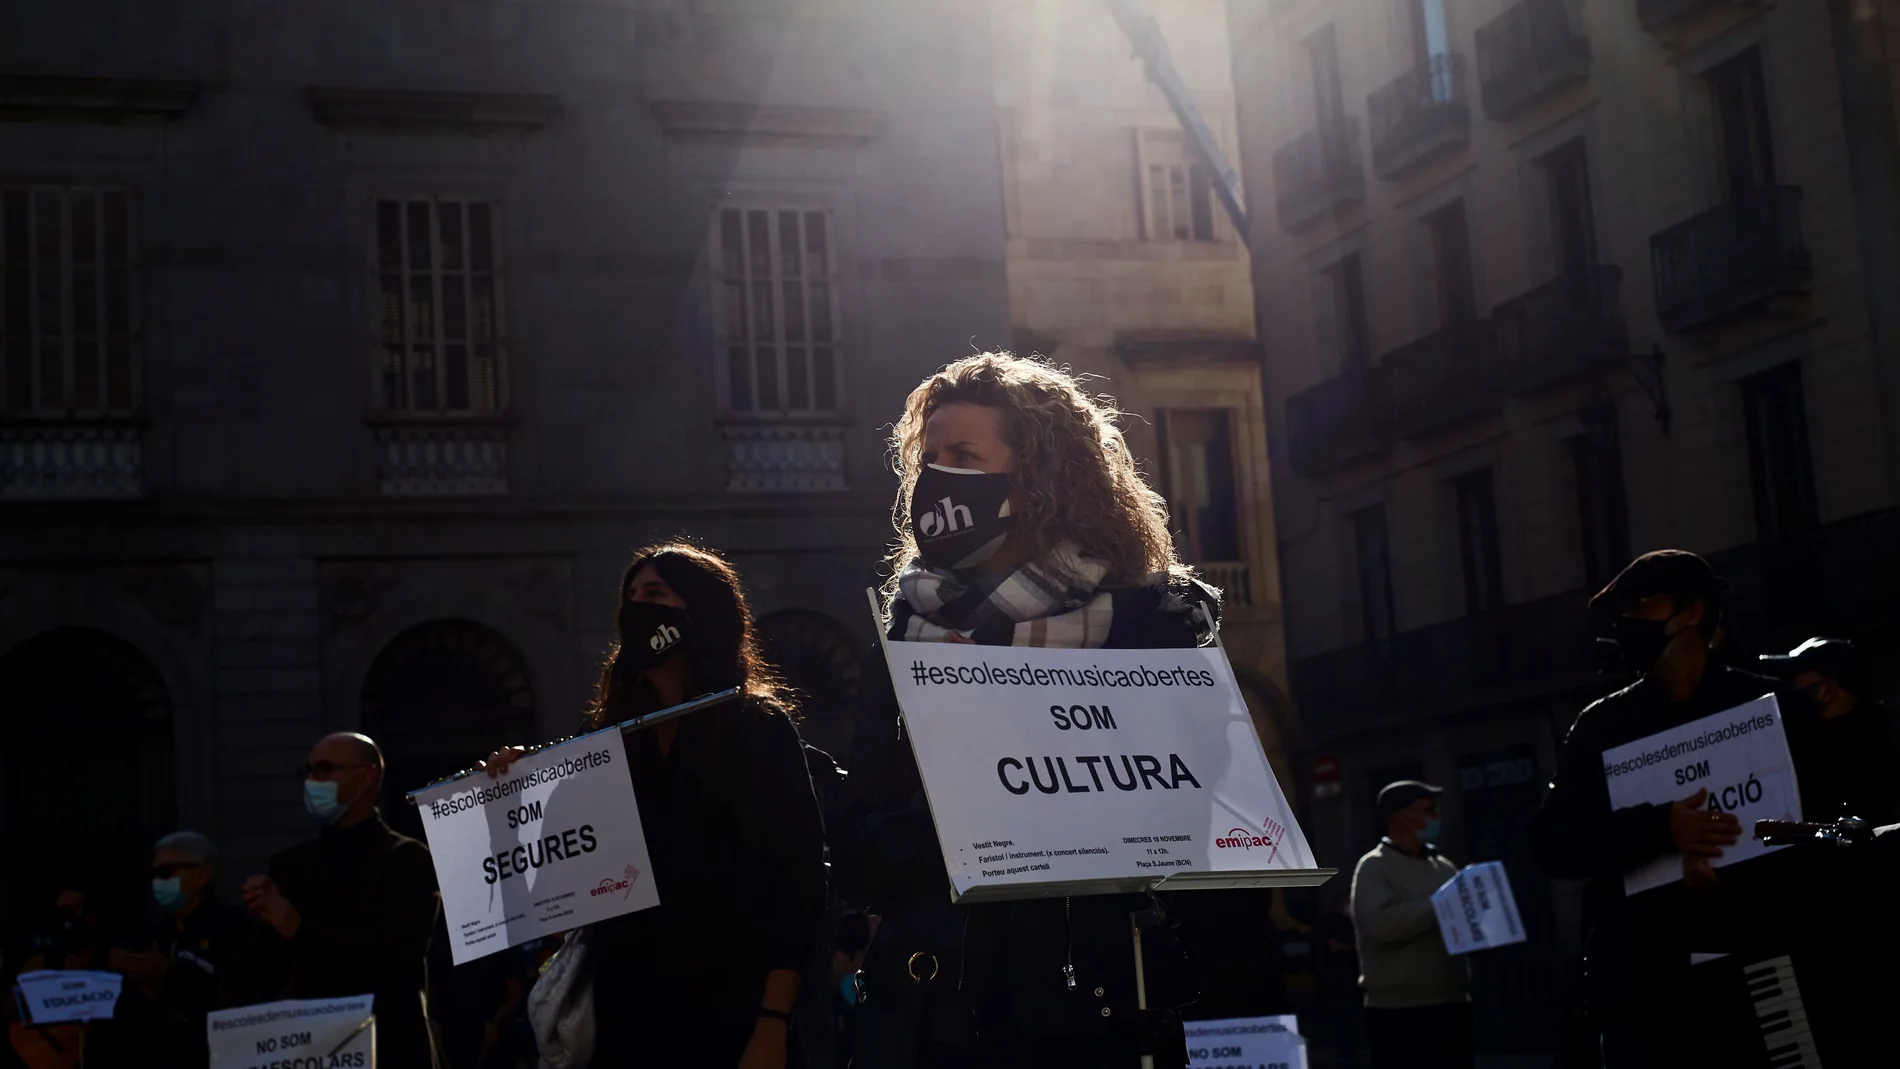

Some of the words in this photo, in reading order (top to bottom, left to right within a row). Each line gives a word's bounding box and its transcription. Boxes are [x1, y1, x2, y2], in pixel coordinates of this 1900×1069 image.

[910, 660, 1215, 688] #escolesdemusicaobertes
[1050, 704, 1118, 731] SOM
[1604, 712, 1774, 778] #escolesdemusicaobertes
[431, 749, 611, 820] #escolesdemusicaobertes
[997, 753, 1202, 796] CULTURA
[1674, 760, 1711, 786] SOM
[507, 800, 543, 830] SOM
[482, 824, 598, 885] SEGURES
[972, 840, 992, 850] Vestit
[993, 840, 1015, 849] Negre.
[1215, 834, 1272, 850] emipac
[978, 853, 1004, 864] Faristol
[1053, 849, 1078, 857] concert
[982, 868, 1005, 878] Porteu
[1006, 865, 1029, 876] aquest
[590, 880, 629, 898] emipac
[256, 1038, 277, 1055] NO
[280, 1031, 312, 1050] SOM
[1189, 1048, 1209, 1060] NO
[1211, 1046, 1242, 1059] SOM
